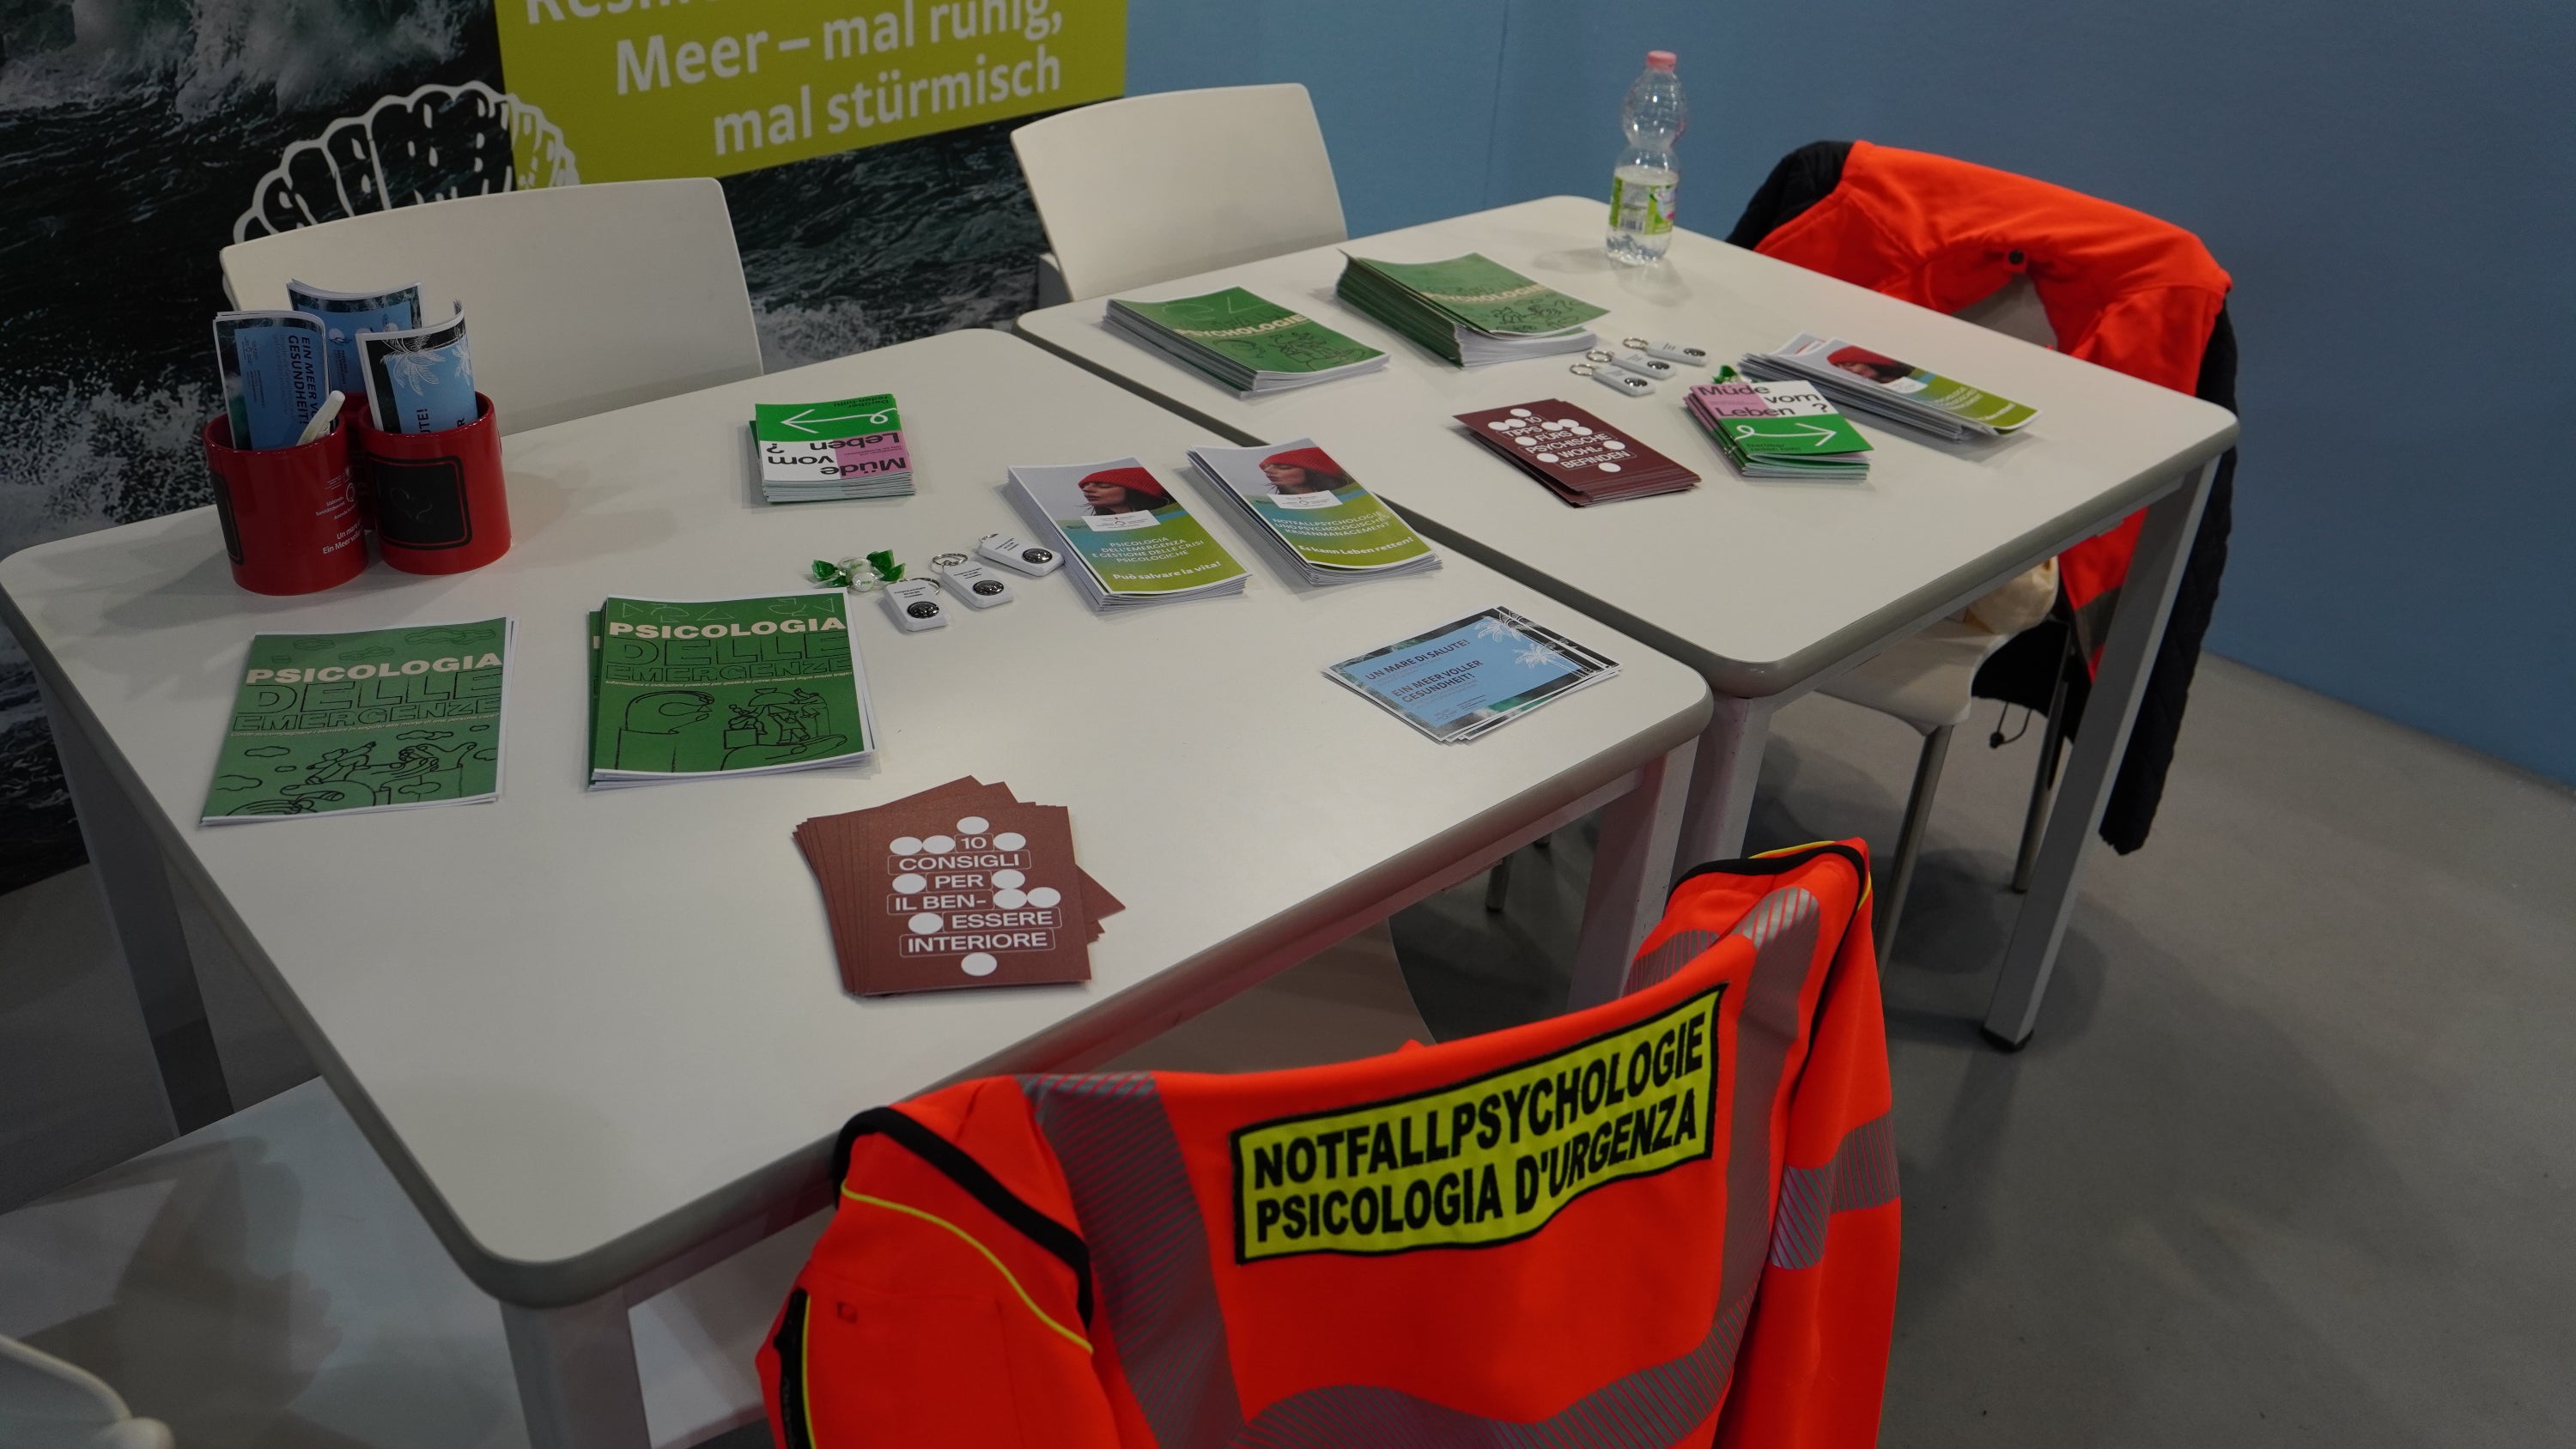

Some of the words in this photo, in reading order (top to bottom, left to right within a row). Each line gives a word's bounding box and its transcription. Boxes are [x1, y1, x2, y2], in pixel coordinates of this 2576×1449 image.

[616, 29, 769, 95] Meer
[823, 0, 914, 62] mal
[930, 0, 1062, 43] ruhig,
[713, 84, 813, 156] mal
[826, 44, 1062, 135] stürmisch
[301, 336, 313, 360] EIN
[289, 335, 310, 424] GESUNDHEIT!
[305, 362, 318, 400] MEER
[1698, 385, 1771, 396] Müde
[1765, 393, 1821, 403] vom
[1715, 407, 1795, 417] Leben
[1812, 403, 1827, 413] ?
[810, 432, 900, 451] Leben
[1503, 426, 1543, 438] TIPPS
[1535, 430, 1573, 441] FÜRS
[767, 443, 785, 454] ?
[1525, 433, 1612, 454] PSYCHISCHE
[1558, 446, 1603, 458] WOHL-
[768, 456, 835, 464] vom
[820, 457, 907, 476] Müde
[1559, 451, 1631, 469] BEFINDEN
[322, 545, 335, 555] Ein
[334, 538, 350, 550] Meer
[1098, 550, 1148, 559] GESTIONE
[1148, 546, 1178, 556] DELLE
[1178, 540, 1205, 550] CRISI
[1100, 539, 1187, 554] DELL'EMERGENZA
[1109, 537, 1170, 549] PSICOLOGIA
[1311, 546, 1340, 555] kann
[1375, 537, 1414, 552] retten!
[1115, 549, 1190, 563] PSICOLOGICHE
[1139, 571, 1181, 580] salvare
[1194, 561, 1222, 573] vita!
[610, 617, 847, 640] PSICOLOGIA
[606, 630, 852, 666] DELLE
[246, 652, 502, 685] PSICOLOGIA
[605, 656, 853, 682] EMERGENZE
[1365, 670, 1385, 680] UN
[1383, 658, 1417, 673] MARE
[1415, 653, 1429, 663] DI
[1425, 639, 1471, 658] SALUTE!
[1391, 685, 1413, 697] EIN
[1412, 673, 1445, 689] MEER
[1441, 659, 1484, 677] VOLLER
[1401, 672, 1476, 703] GESUNDHEIT!
[240, 667, 502, 714] DELLE
[233, 696, 501, 731] EMERGENZE
[960, 837, 987, 850] 10
[898, 852, 1019, 872] CONSIGLI
[934, 875, 984, 888] PER
[896, 896, 917, 911] IL
[923, 894, 987, 910] BEN-
[951, 910, 1054, 930] ESSERE
[908, 931, 1048, 954] INTERIORE
[1253, 1012, 1706, 1189] NOTFALLPSYCHOLOGIE
[1255, 1164, 1504, 1243] PSICOLOGIA
[1515, 1088, 1697, 1215] D'URGENZA
